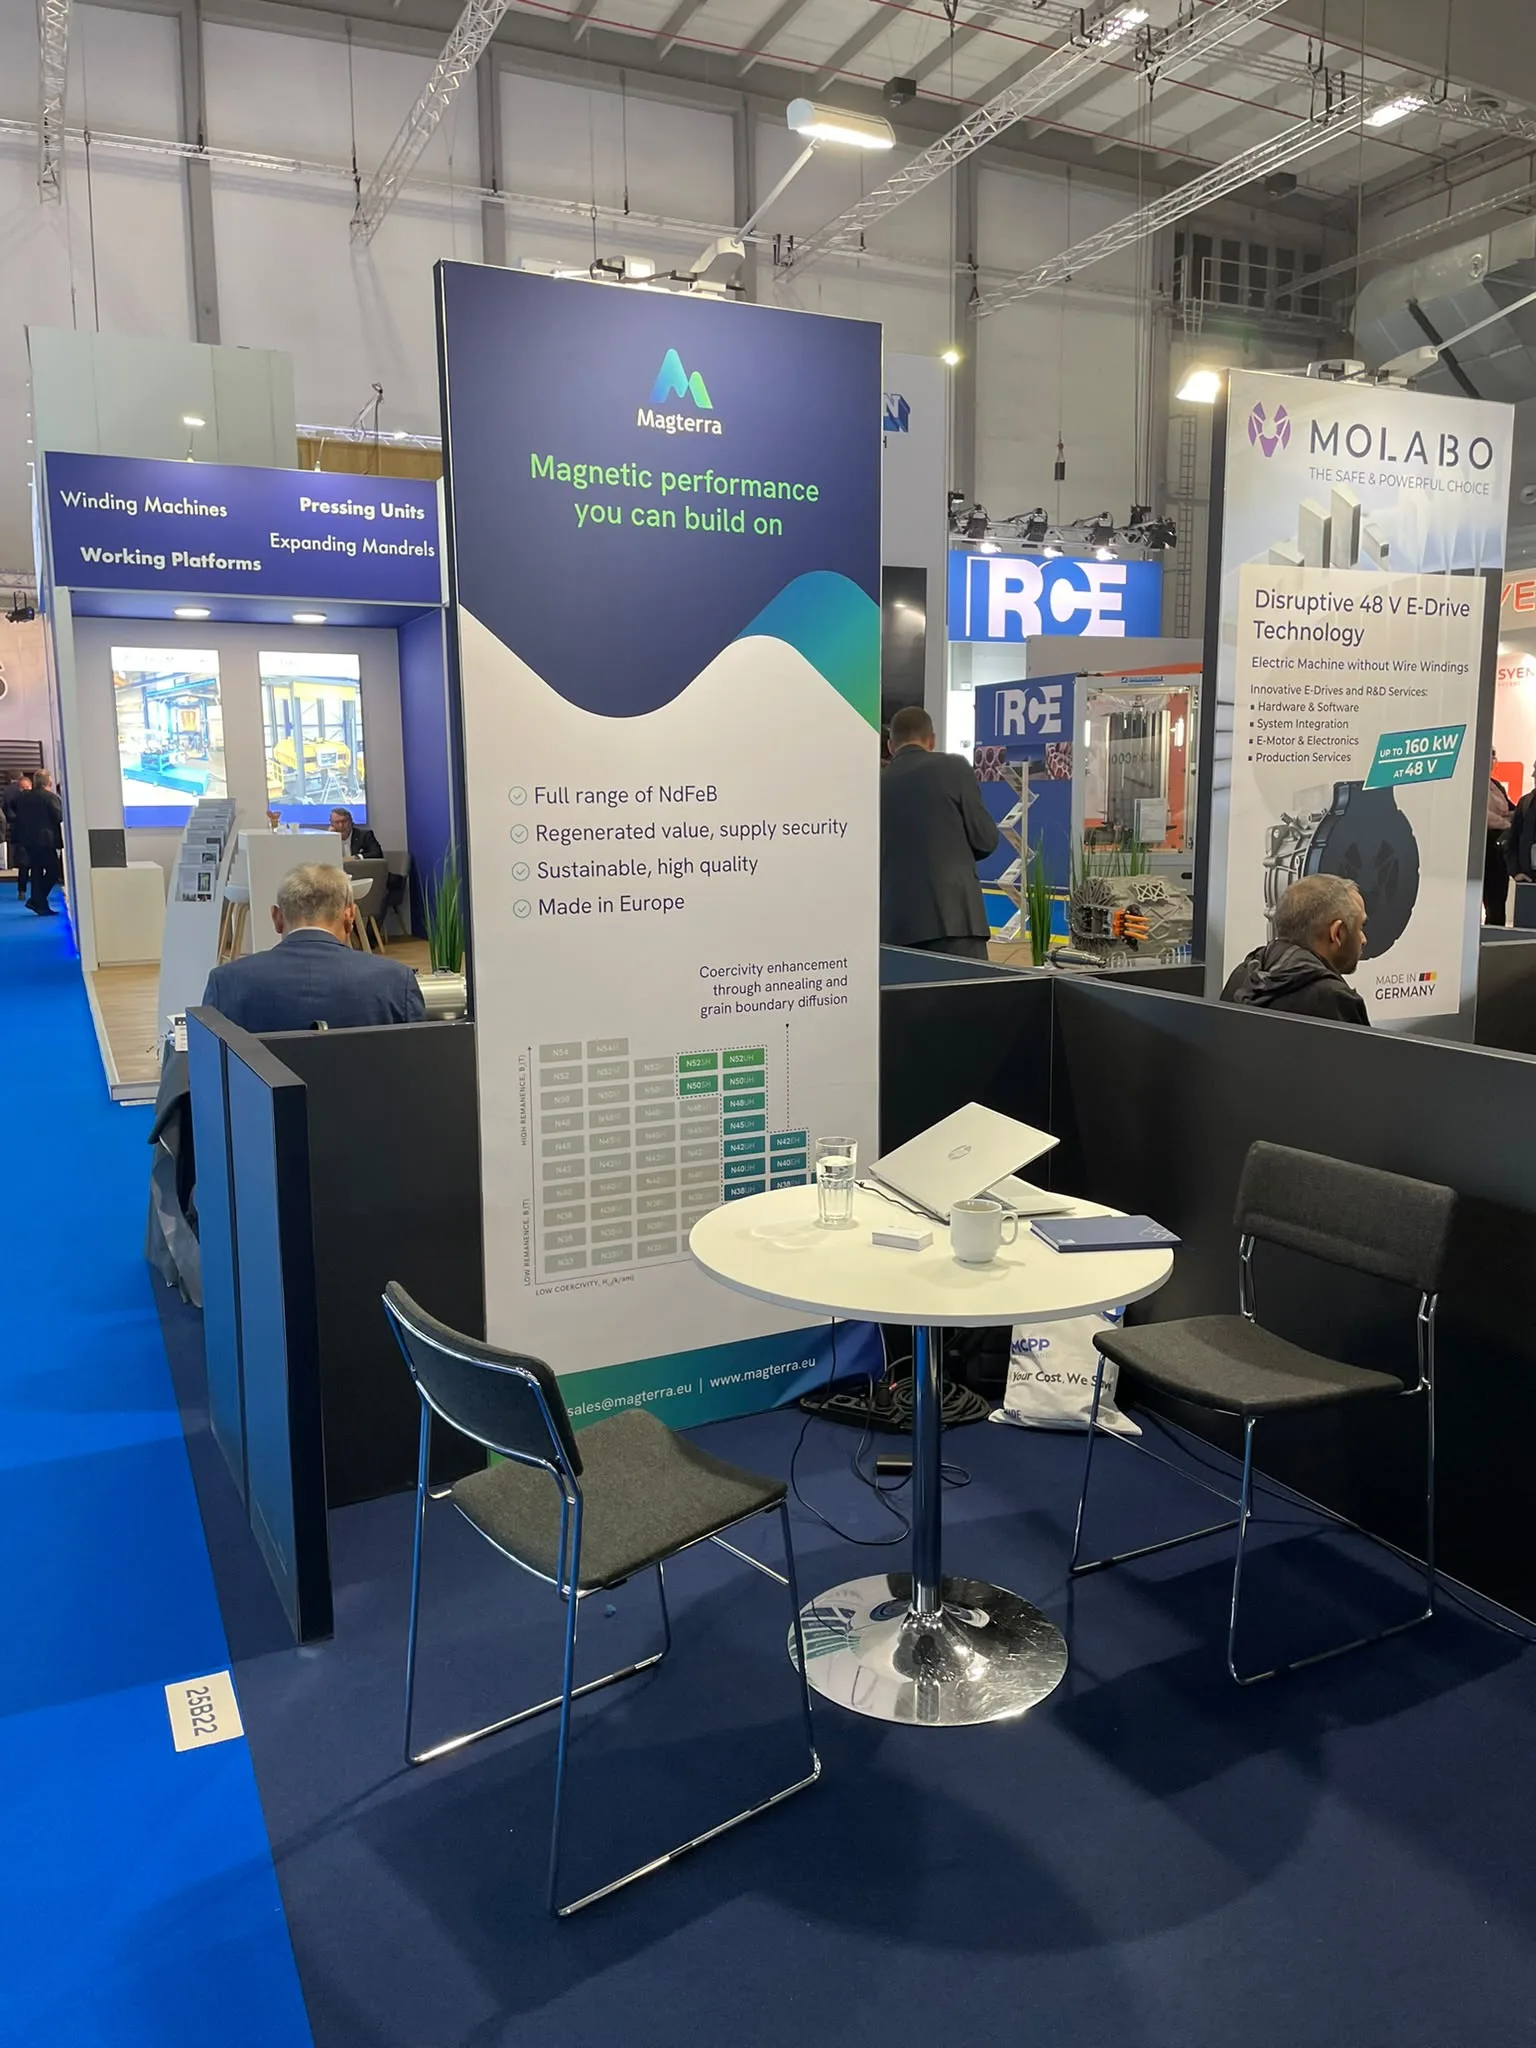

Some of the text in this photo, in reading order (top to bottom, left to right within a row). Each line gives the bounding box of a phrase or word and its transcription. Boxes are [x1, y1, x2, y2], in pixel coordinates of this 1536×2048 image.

[637, 408, 722, 434] Magterra
[1310, 420, 1493, 470] MOLABO
[531, 453, 820, 502] Magnetic performance
[1309, 467, 1490, 495] THE SAFE & POWERFUL CHOICE
[60, 490, 228, 518] Winding Machines
[300, 497, 425, 520] Pressing Units
[575, 503, 783, 535] you can build on
[270, 533, 435, 557] Expanding Mandrels
[80, 547, 262, 572] Working Platforms
[1256, 590, 1470, 617] Disruptive 48 V E-Drive
[1254, 621, 1365, 646] Technology
[1252, 657, 1469, 675] Electric Machine without Wire Windings
[1250, 684, 1428, 697] Innovative E-Drives and R&D Services:
[1258, 702, 1359, 713] Hardware & Software
[1257, 718, 1349, 731] System Integration
[1256, 735, 1359, 746] E-Motor & Electronics
[1380, 734, 1457, 758] UP TO 160 kW
[1256, 752, 1351, 763] Production Services
[1393, 759, 1437, 778] AT 48 V
[535, 785, 718, 808] Full range of NdFeB
[536, 818, 848, 846] Regenerated value, supply security
[537, 856, 758, 879] Sustainable, high quality
[539, 895, 685, 916] Made in Europe
[700, 957, 848, 979] Coercivity enhancement
[1375, 973, 1416, 986] MADE IN
[713, 976, 848, 998] through annealing and
[1375, 984, 1436, 1001] GERMANY
[700, 993, 848, 1019] grain boundary diffusion
[519, 1126, 528, 1146] HIGH
[522, 1269, 531, 1286] LOW
[535, 1287, 553, 1296] LOW
[1011, 1338, 1050, 1354] MCPP
[567, 1357, 816, 1417] sales@magterra.eu www.magterra.eu
[1012, 1371, 1033, 1382] Your
[1066, 1373, 1088, 1386] We
[185, 1686, 218, 1737] 25B22
